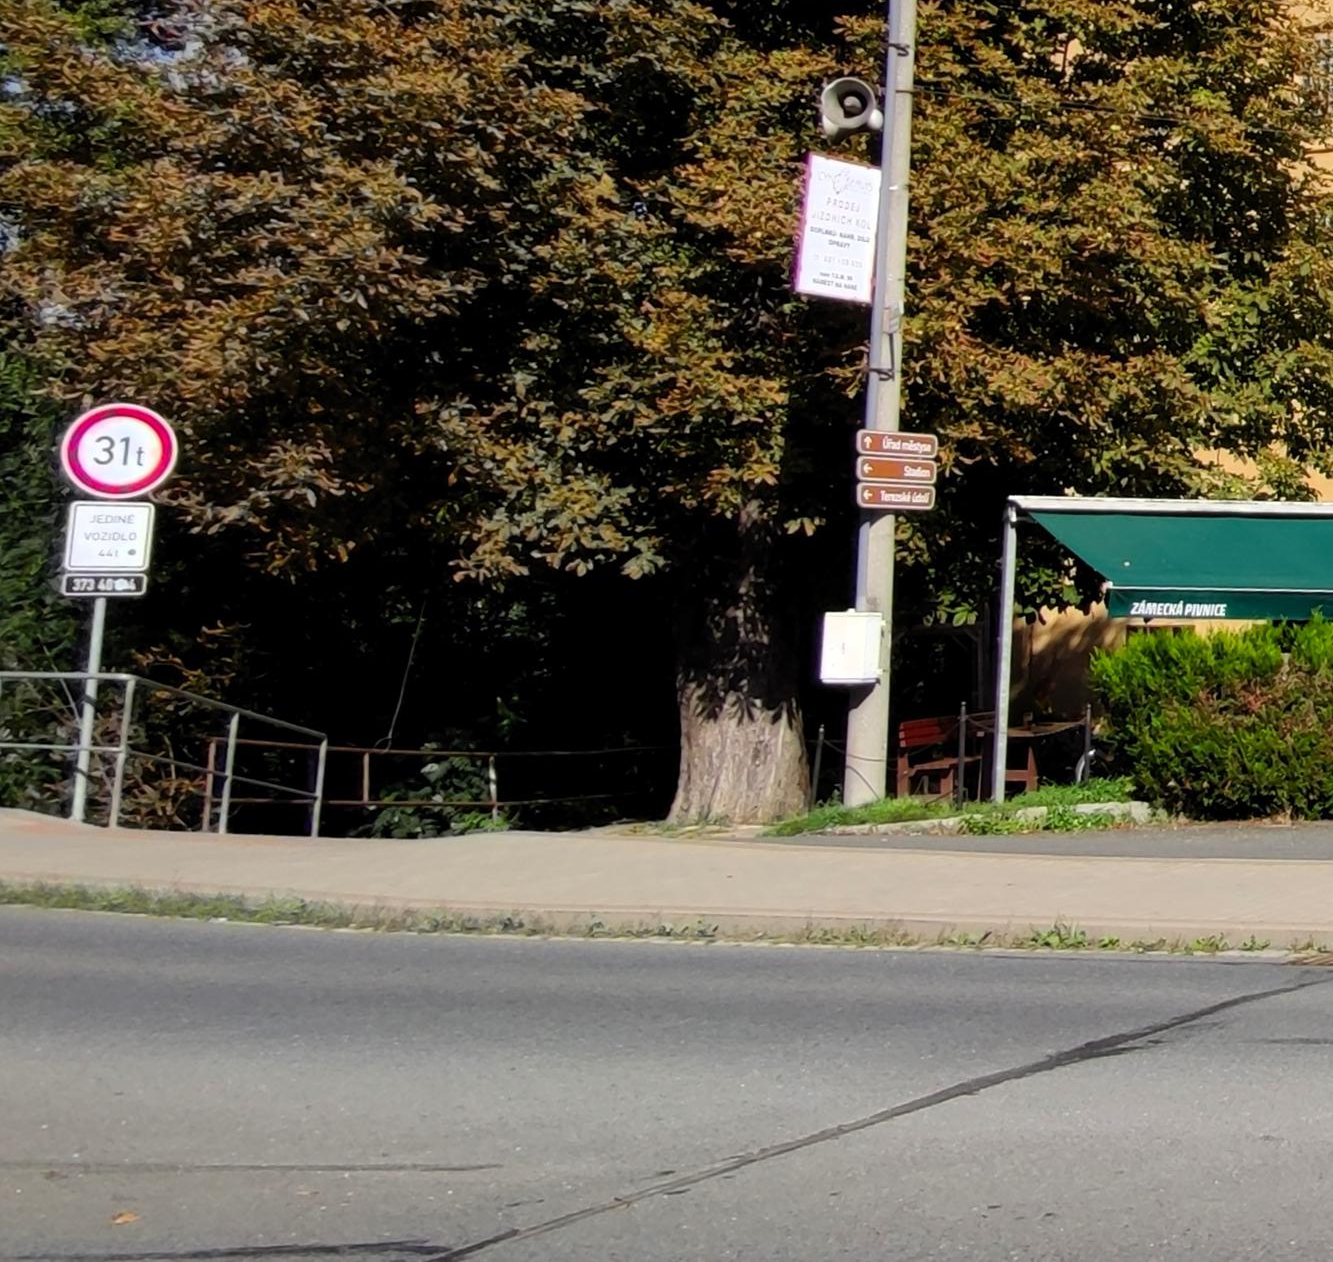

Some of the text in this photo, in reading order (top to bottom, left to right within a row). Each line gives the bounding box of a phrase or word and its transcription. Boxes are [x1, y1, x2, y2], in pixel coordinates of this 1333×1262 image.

[84, 531, 137, 542] VOZIDLO
[72, 578, 95, 592] 373
[1130, 600, 1227, 616] ZÁMECKÁ PIVNICE
